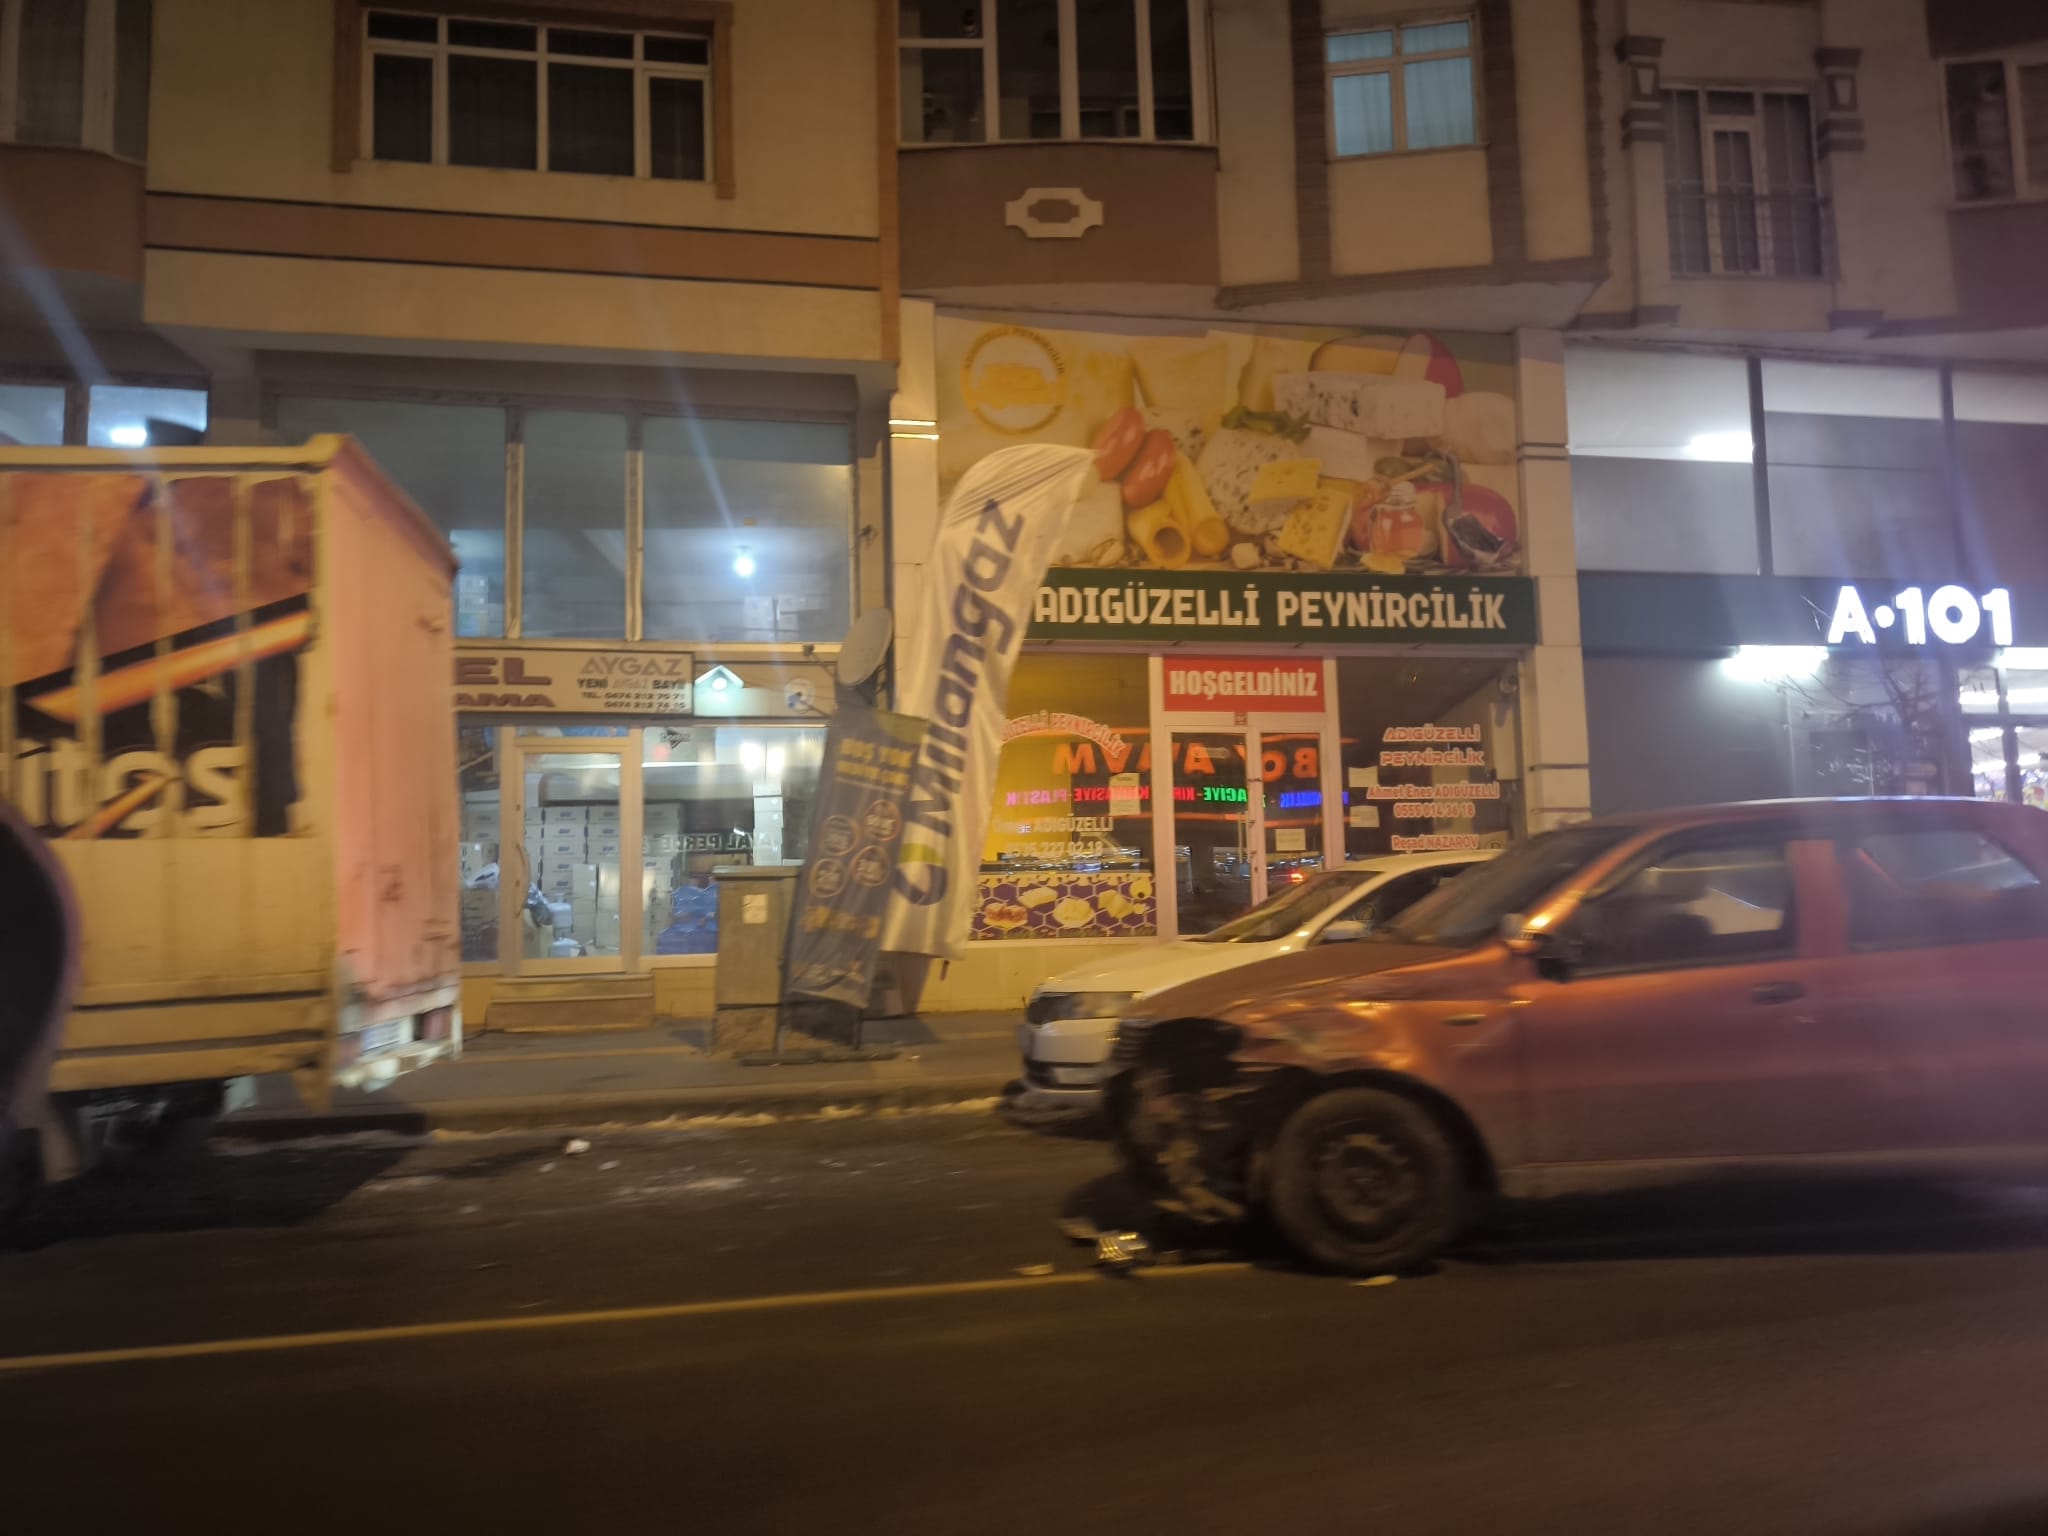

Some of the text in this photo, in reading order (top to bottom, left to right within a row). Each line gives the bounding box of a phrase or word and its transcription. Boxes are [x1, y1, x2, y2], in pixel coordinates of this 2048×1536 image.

[1034, 582, 1507, 630] ADIGÜZELLİ PEYNİRCİLİK
[580, 655, 682, 677] AYGAZ
[918, 498, 1026, 839] Milangaz
[1169, 668, 1319, 700] HOŞGELDİNİZ
[1383, 723, 1481, 742] ADIGÜZELLİ
[1380, 748, 1485, 767] PEYNİRCİLİK
[1367, 784, 1405, 800] Ahmet
[1407, 784, 1433, 799] Enes
[1434, 781, 1500, 800] ADIGÜZELLİ
[1394, 802, 1422, 818] 0555
[1423, 802, 1444, 818] 014
[1426, 834, 1480, 851] NAZAROV
